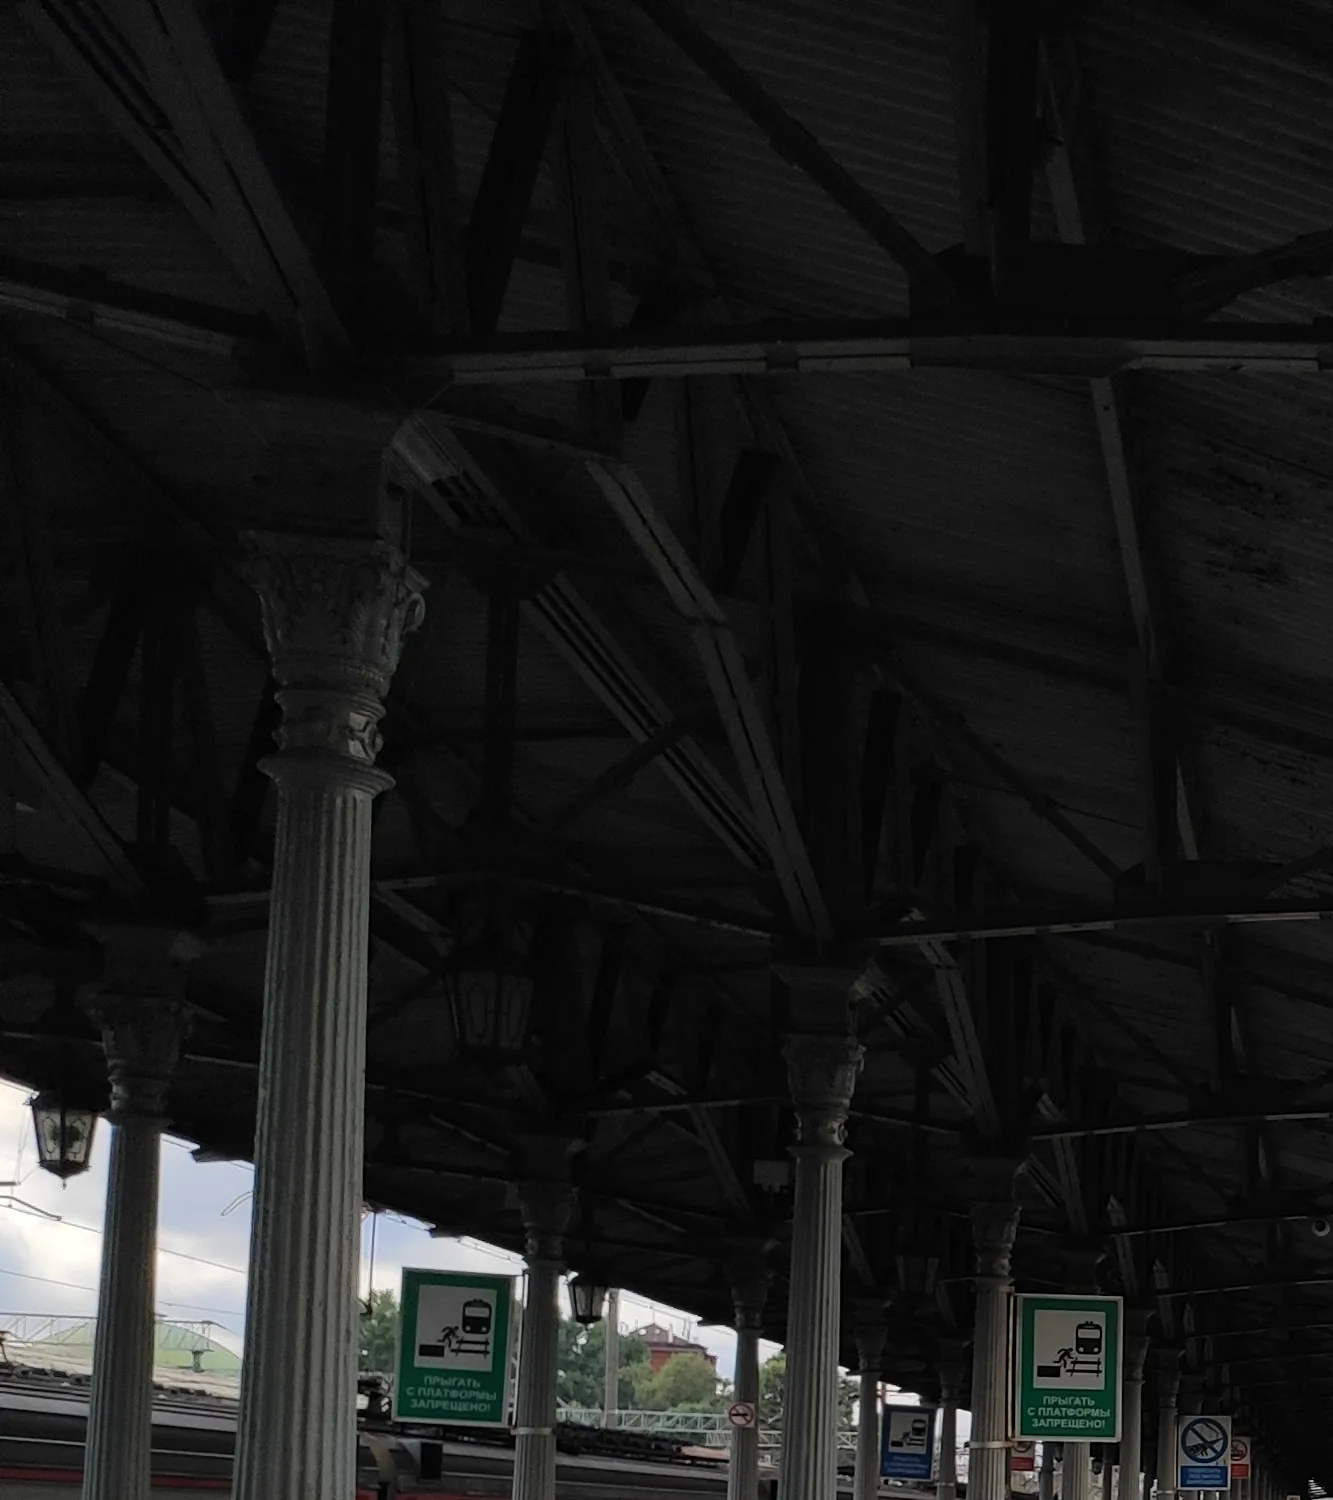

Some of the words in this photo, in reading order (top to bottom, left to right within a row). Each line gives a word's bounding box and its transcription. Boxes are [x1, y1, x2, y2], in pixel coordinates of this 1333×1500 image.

[424, 1375, 481, 1388] ПРЫГАТЬ
[406, 1386, 415, 1396] С
[418, 1386, 497, 1401] ПЛАТФОРМЫ
[410, 1398, 491, 1412] ЗАПРЕЩЕНО!
[1043, 1395, 1095, 1406] ПРЫГАТЬ
[1027, 1407, 1036, 1416] С
[1038, 1407, 1110, 1417] ПЛАТФОРМЫ
[1032, 1418, 1106, 1429] ЗАПРЕЩЕНО!
